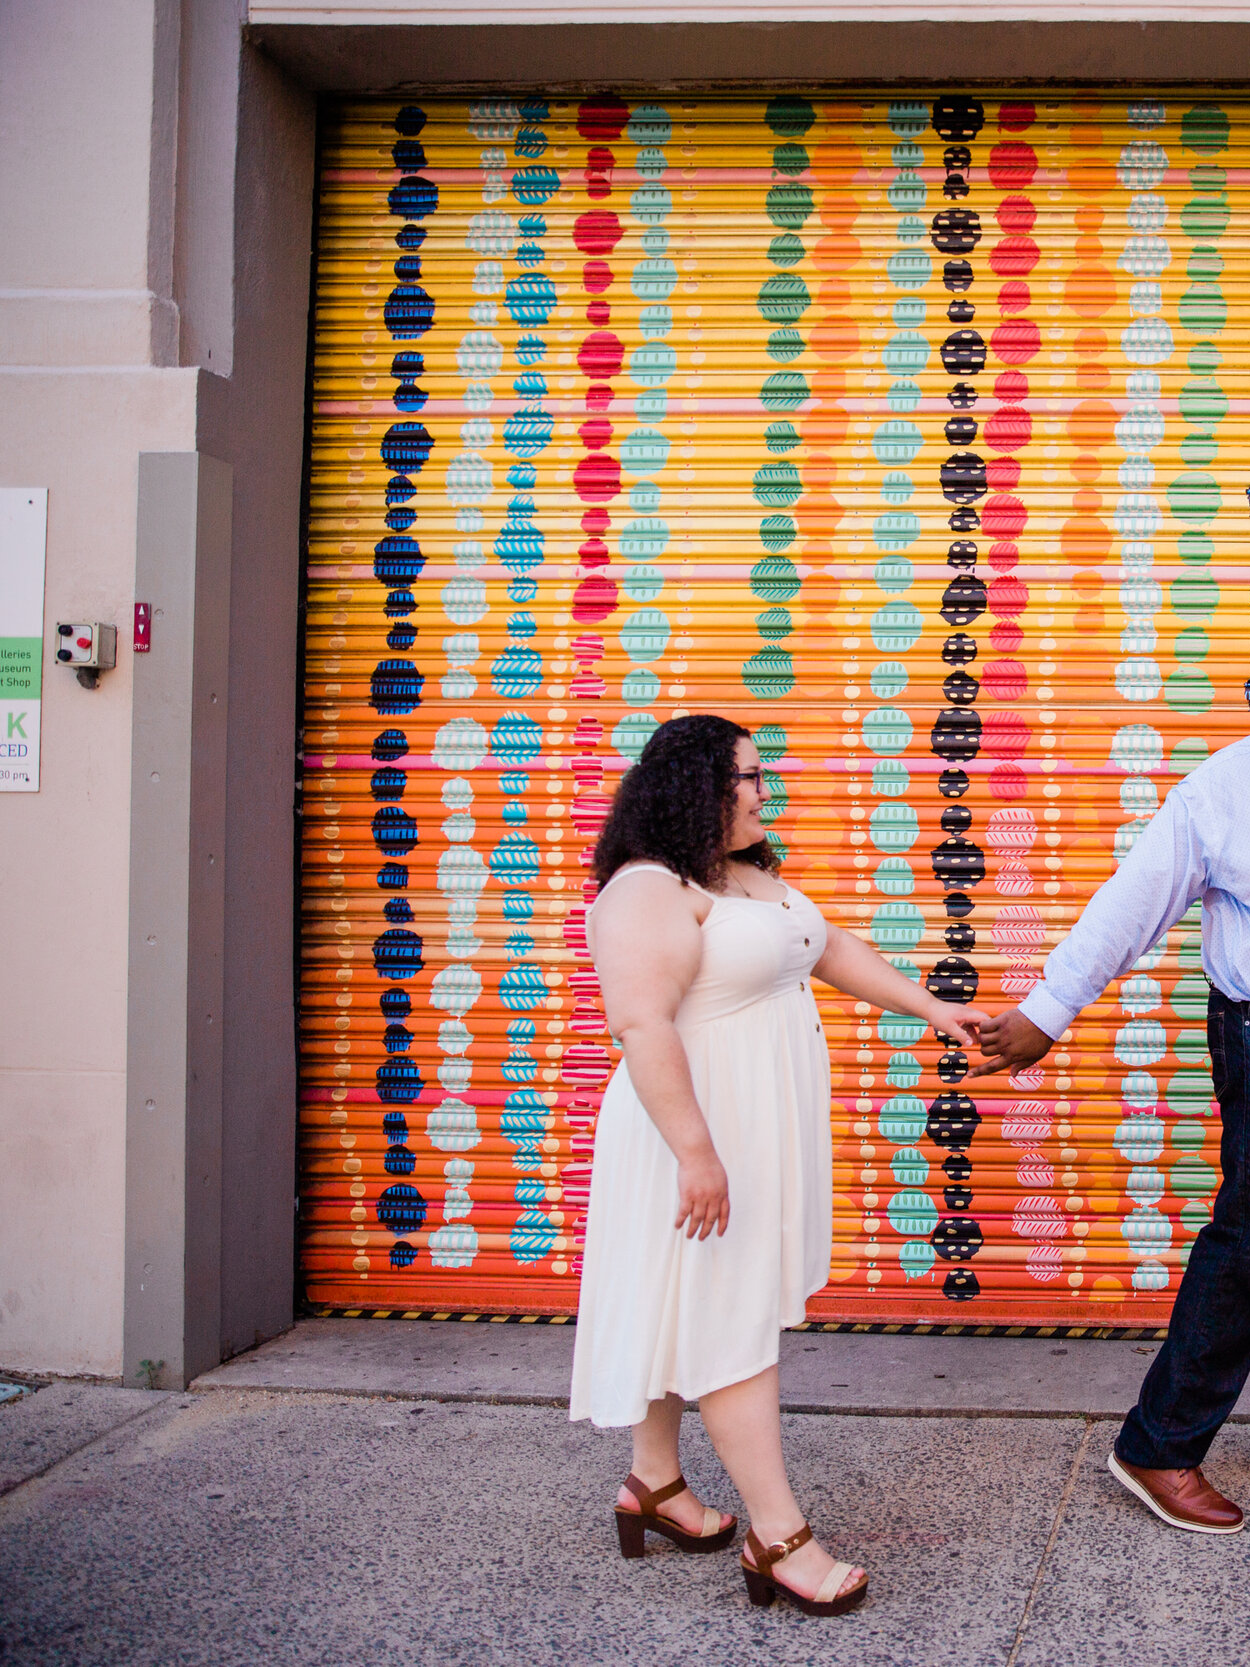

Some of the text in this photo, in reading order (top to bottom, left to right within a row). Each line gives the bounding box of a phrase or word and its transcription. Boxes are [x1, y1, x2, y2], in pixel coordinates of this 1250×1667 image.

[6, 677, 31, 688] Shop
[7, 712, 28, 738] K
[12, 772, 29, 782] pm
